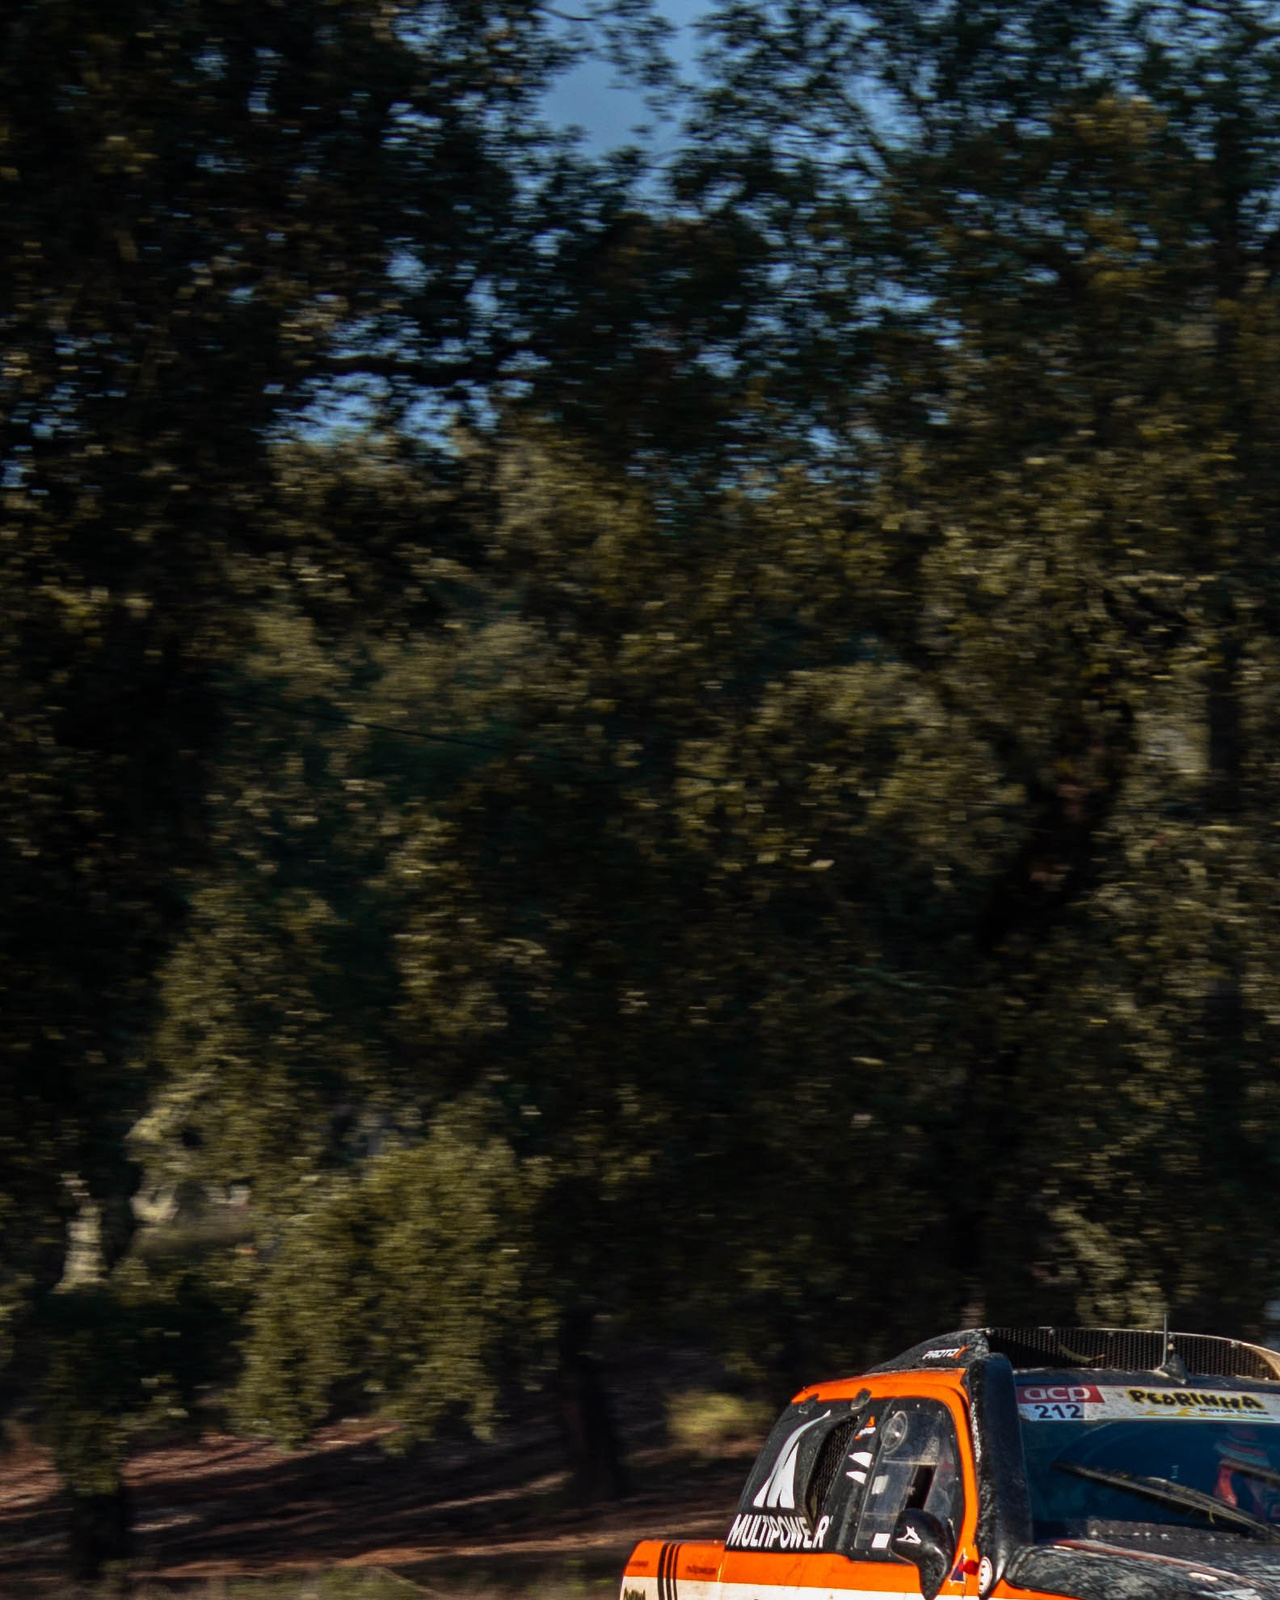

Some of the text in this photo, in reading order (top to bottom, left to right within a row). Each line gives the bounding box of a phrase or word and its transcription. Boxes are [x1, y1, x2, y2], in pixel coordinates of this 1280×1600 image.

[1024, 1387, 1091, 1402] acp
[1034, 1404, 1085, 1419] 212
[726, 1513, 830, 1550] MULTIPOWER
